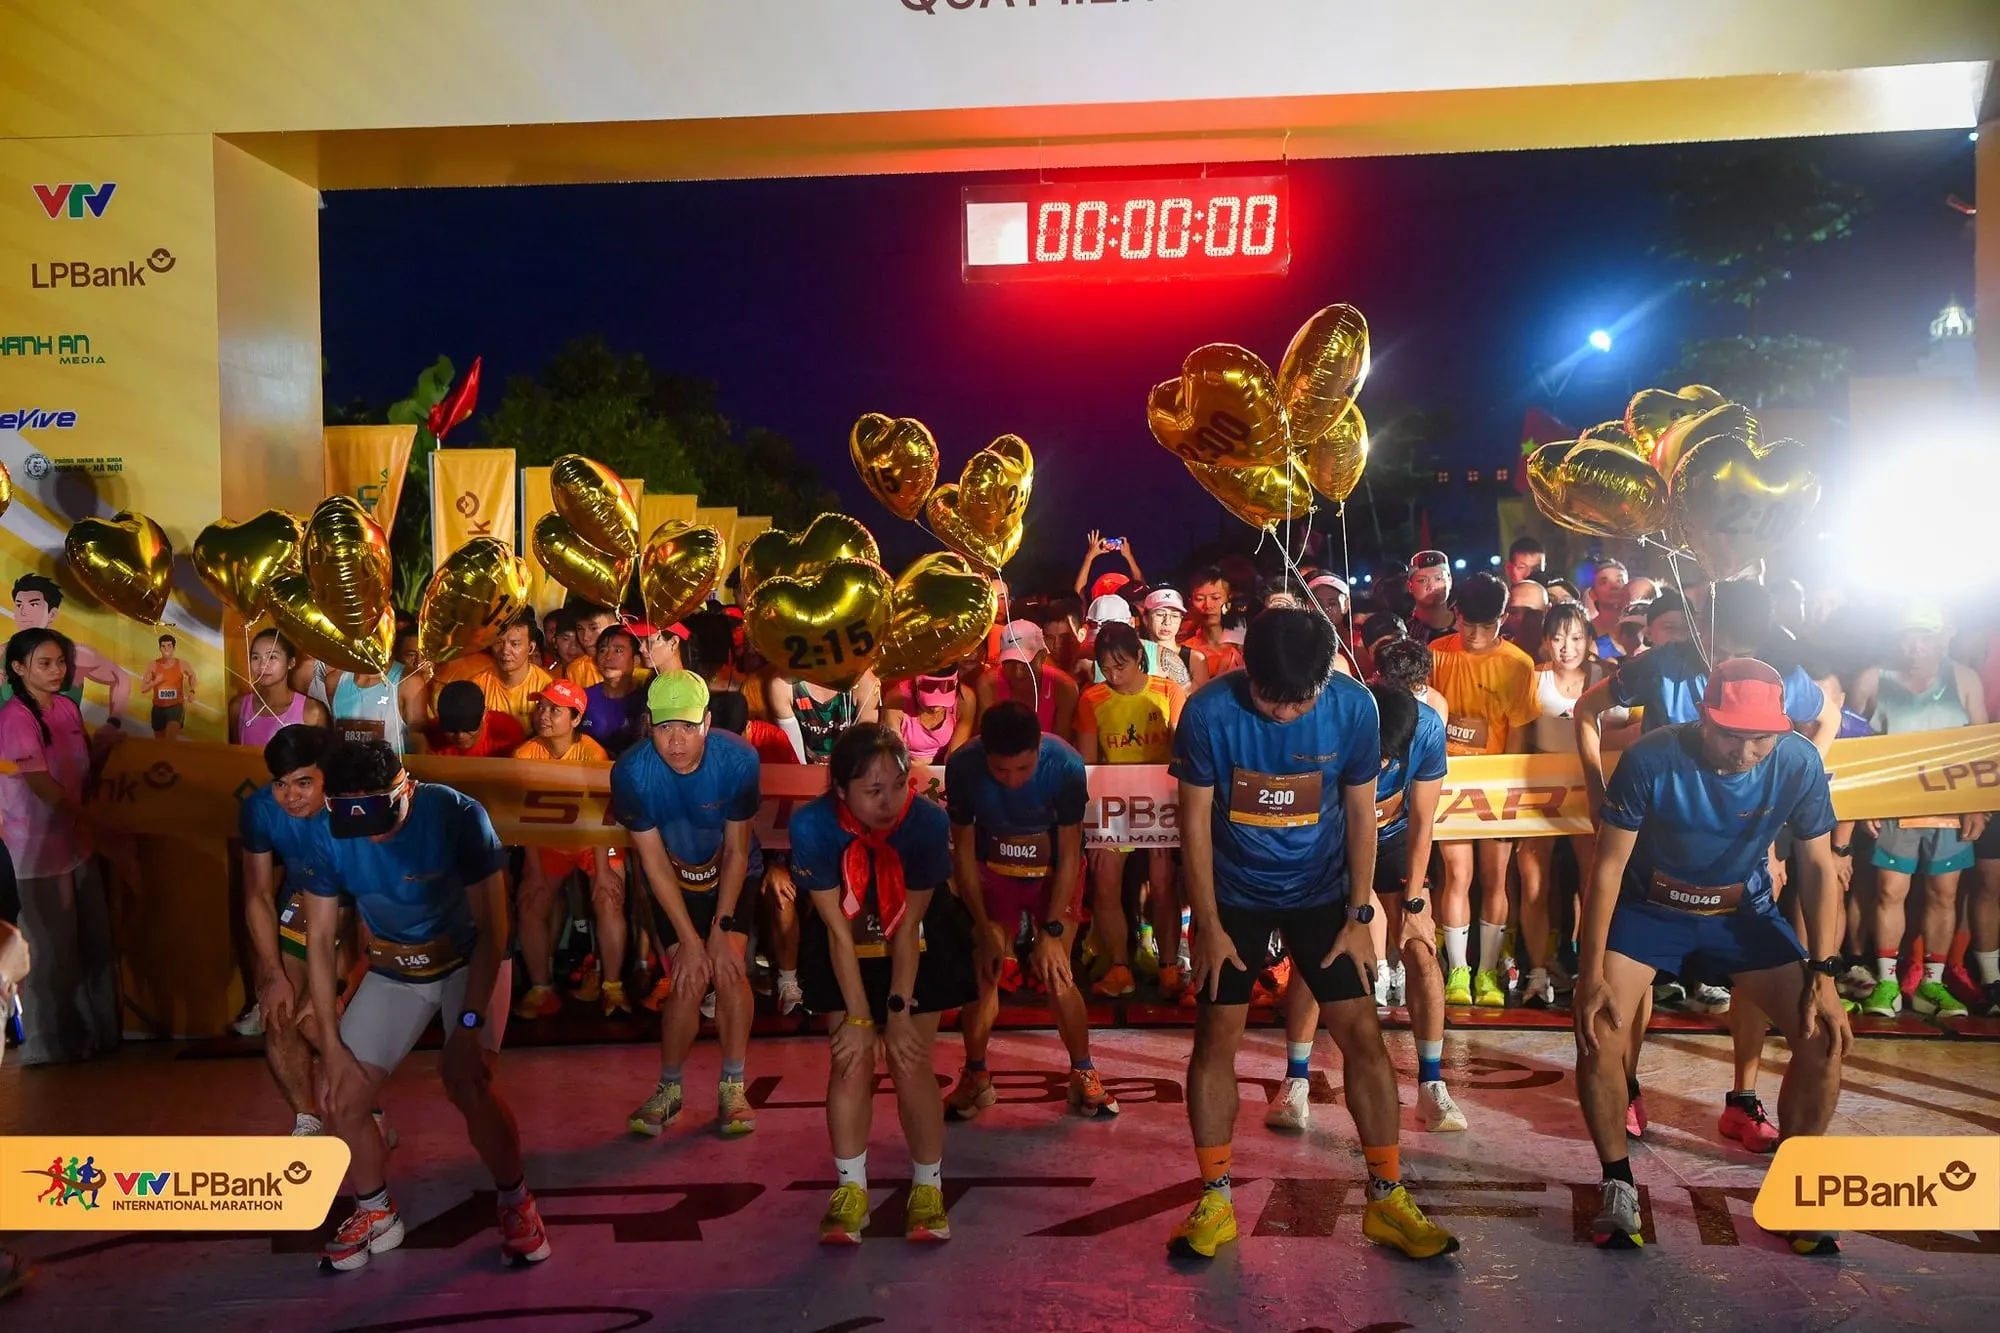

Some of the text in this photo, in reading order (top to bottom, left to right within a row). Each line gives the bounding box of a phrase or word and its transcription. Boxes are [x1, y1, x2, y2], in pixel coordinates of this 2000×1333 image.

[33, 183, 116, 218] VTV
[1036, 195, 1278, 262] 00:00:00
[32, 260, 146, 288] LPBank
[58, 335, 90, 354] AN
[784, 618, 874, 670] 2:15
[1258, 789, 1295, 805] 2:00
[1000, 843, 1037, 858] 90042
[1669, 890, 1721, 904] 90046
[395, 953, 430, 966] 1:45
